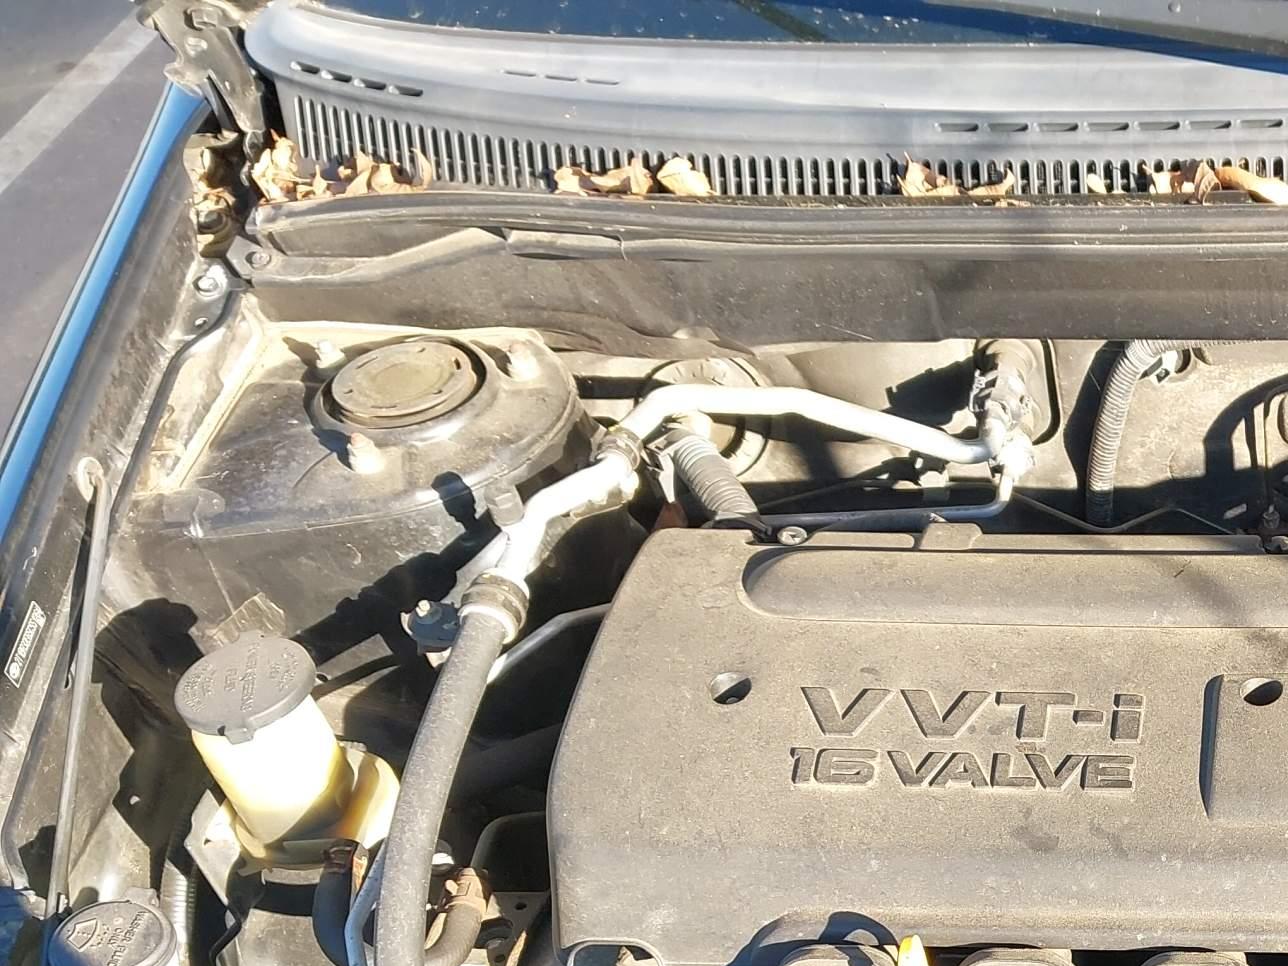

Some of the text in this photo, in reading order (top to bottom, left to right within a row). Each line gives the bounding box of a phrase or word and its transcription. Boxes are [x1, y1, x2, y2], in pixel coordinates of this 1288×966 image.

[790, 747, 1137, 791] 16 VALVE
[107, 927, 124, 945] ONLY
[121, 911, 149, 942] WASHER
